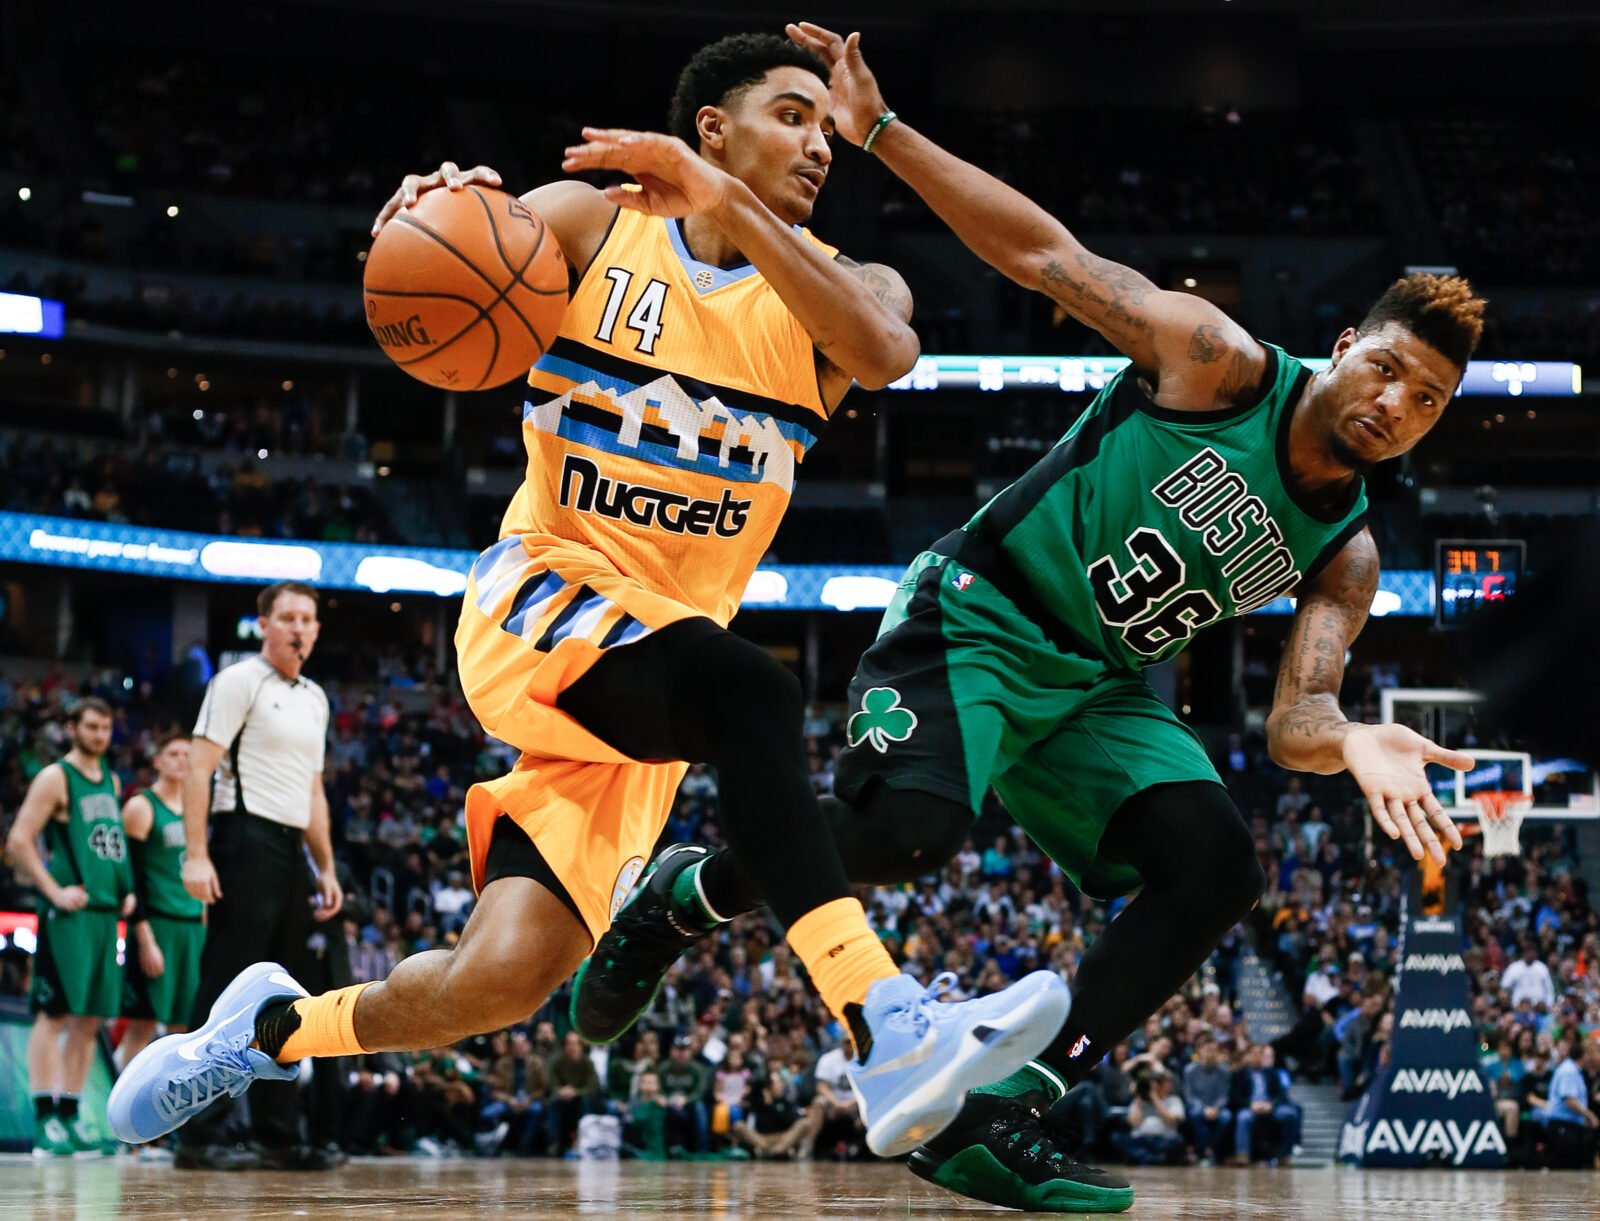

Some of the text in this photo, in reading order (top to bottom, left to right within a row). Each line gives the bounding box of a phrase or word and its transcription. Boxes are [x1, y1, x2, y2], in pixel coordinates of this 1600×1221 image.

[373, 314, 437, 347] DING.
[592, 268, 671, 356] 14
[559, 455, 752, 537] Nuggets
[1087, 527, 1222, 655] 36
[1405, 954, 1465, 975] AVAYA
[1400, 1008, 1471, 1032] AVAYA
[1391, 1068, 1483, 1099] AVAYA
[1367, 1119, 1507, 1165] AVAYA
